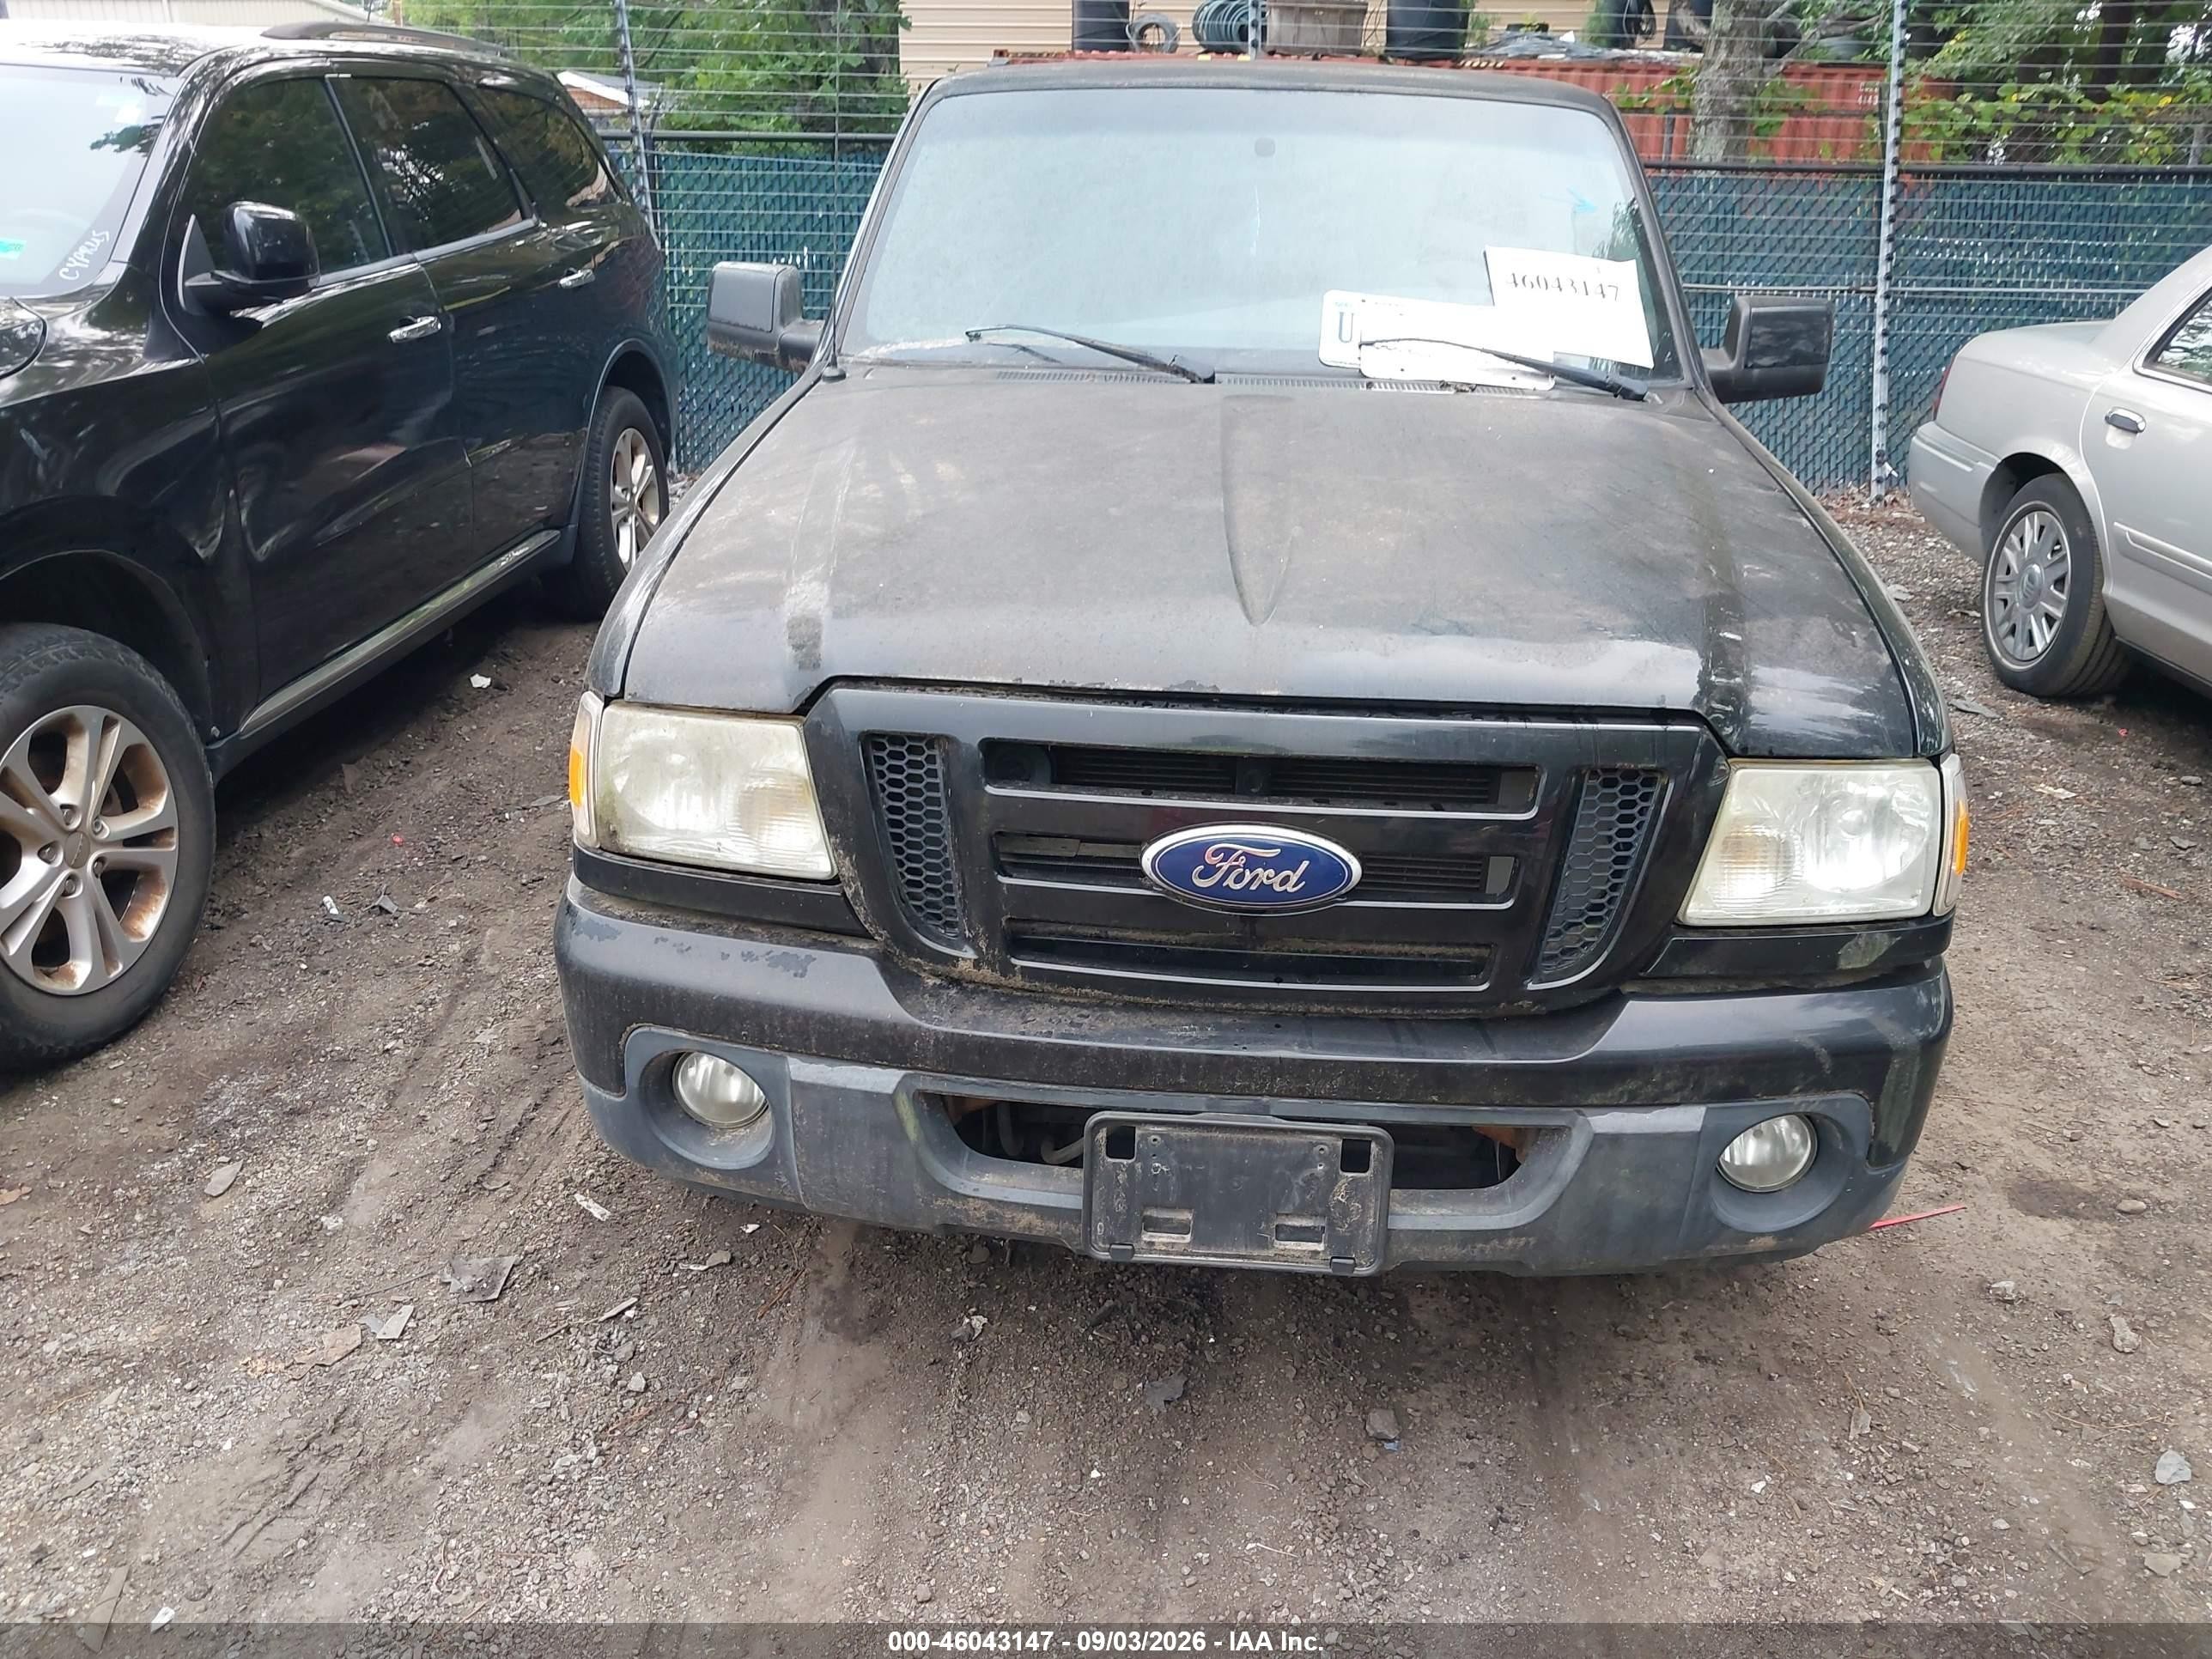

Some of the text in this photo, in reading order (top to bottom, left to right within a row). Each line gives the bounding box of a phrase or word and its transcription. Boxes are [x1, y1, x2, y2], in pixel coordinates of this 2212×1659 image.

[58, 229, 110, 281] CYPRUS
[1506, 272, 1620, 301] 46043147
[1192, 843, 1310, 894] Ford
